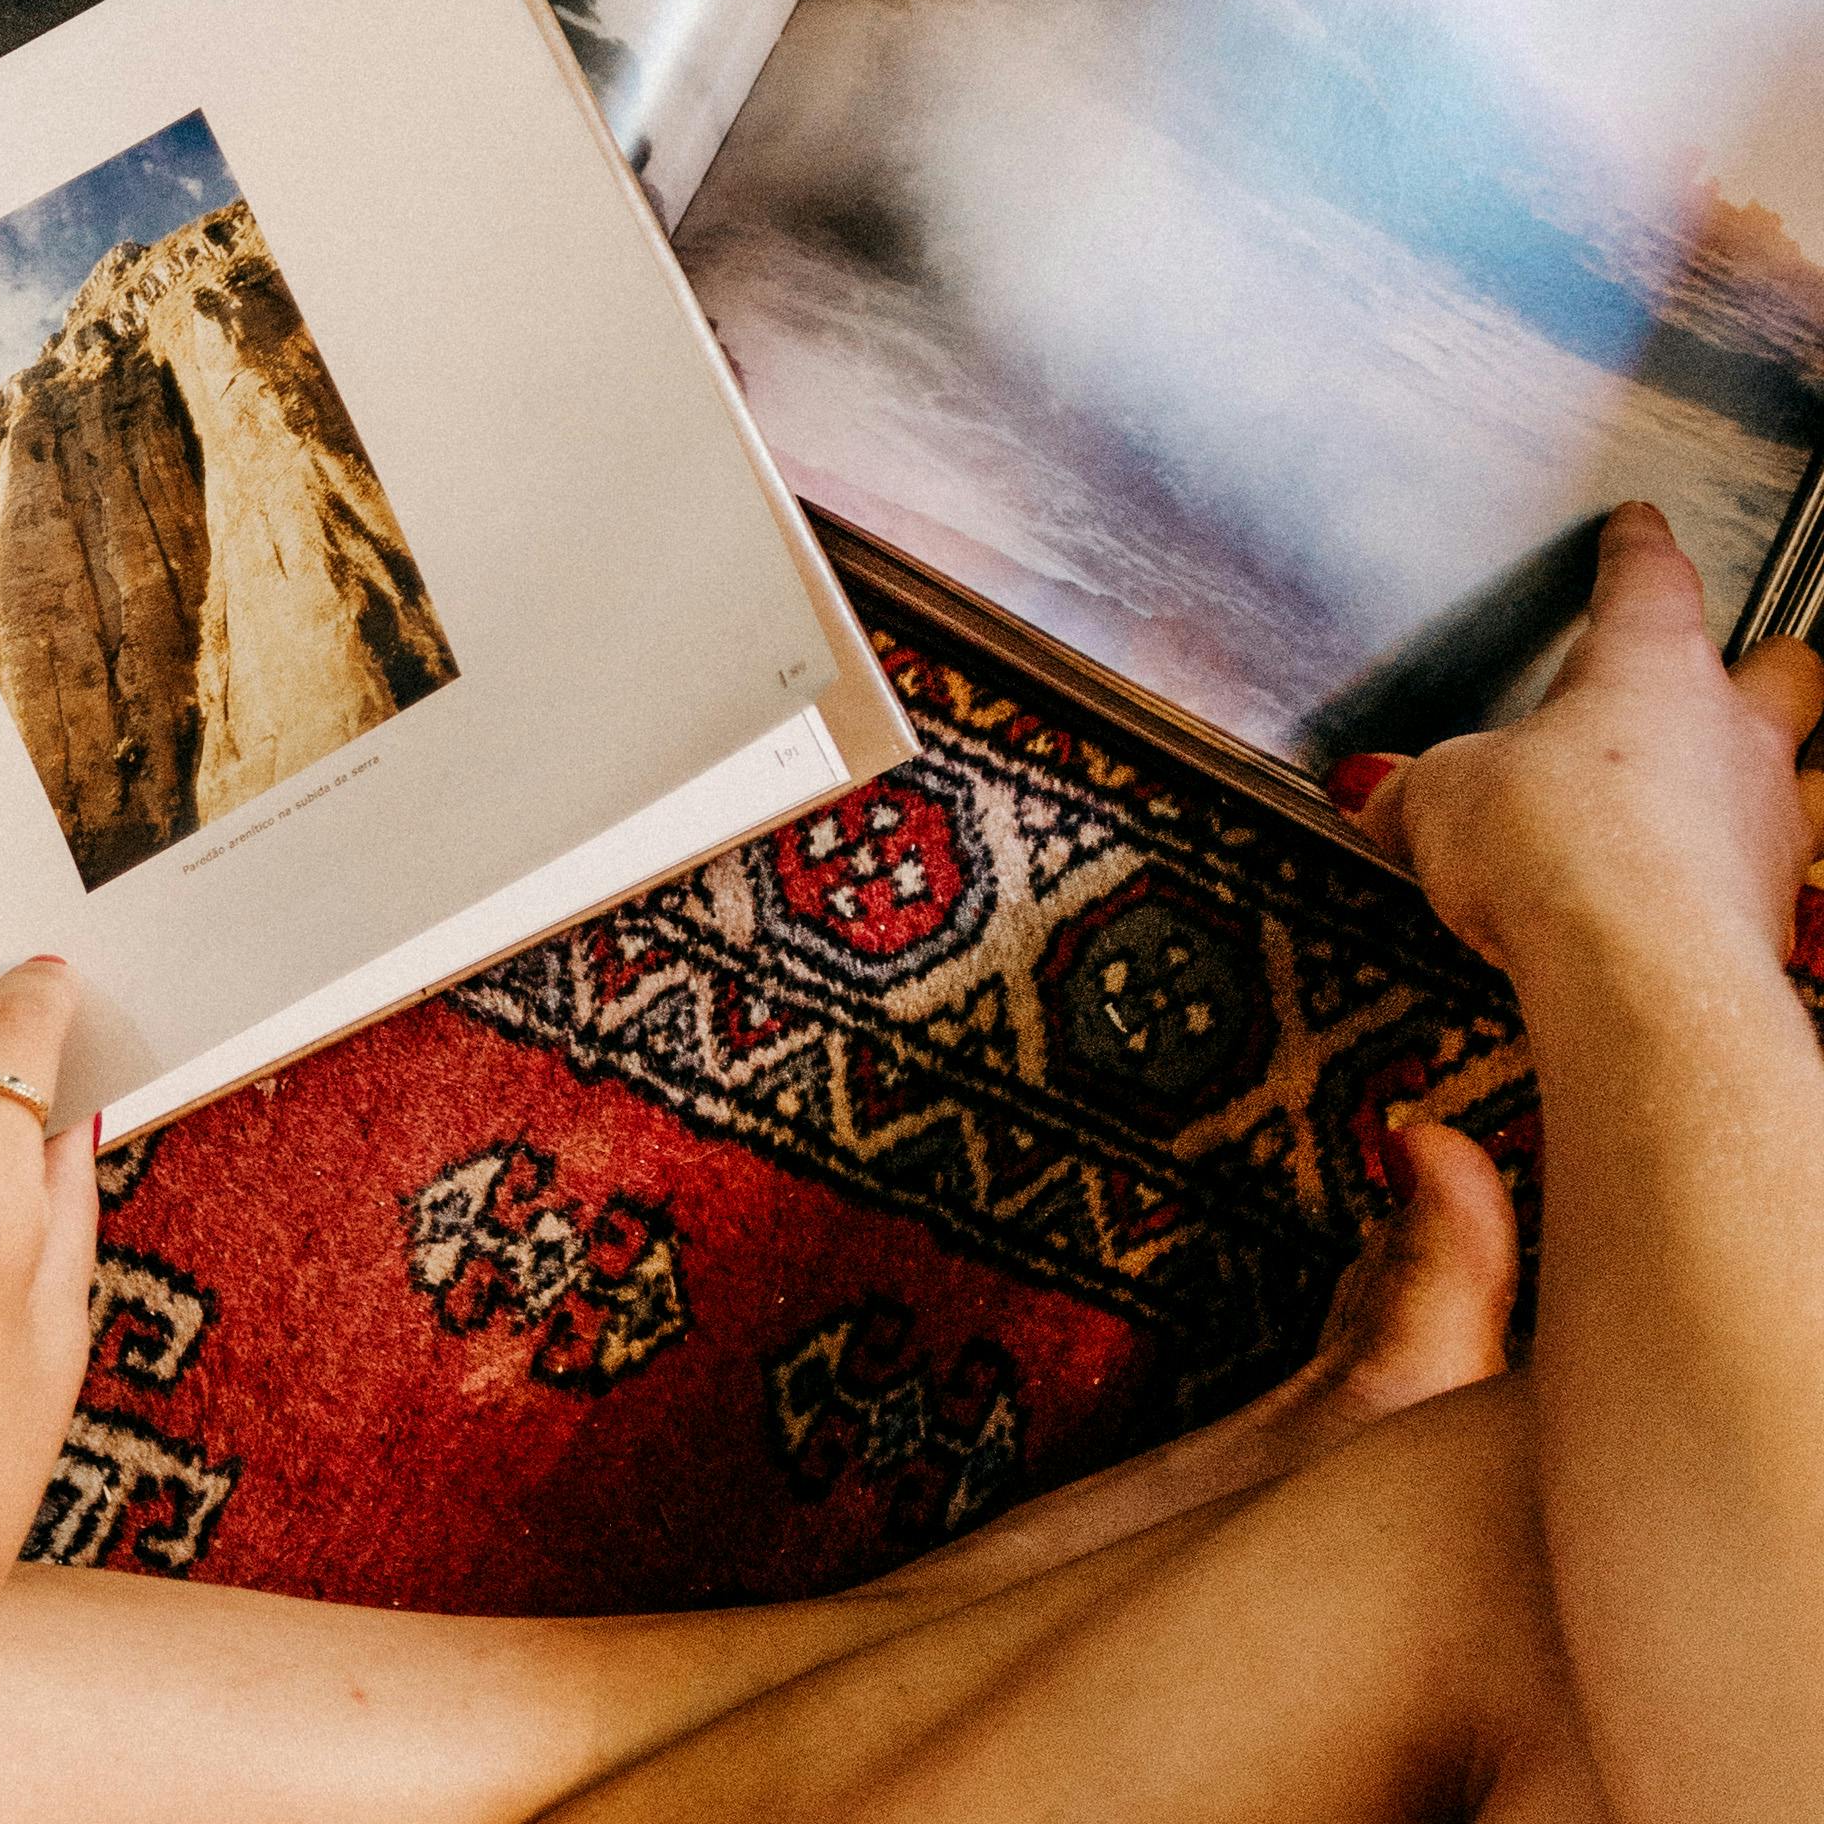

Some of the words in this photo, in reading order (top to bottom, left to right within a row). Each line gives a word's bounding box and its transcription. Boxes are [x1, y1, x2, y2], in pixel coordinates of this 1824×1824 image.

[182, 846, 225, 874] Paredão
[229, 817, 274, 849] arenítico
[278, 808, 292, 820] na
[296, 784, 330, 810] subida
[335, 774, 347, 787] da
[352, 756, 379, 777] serra
